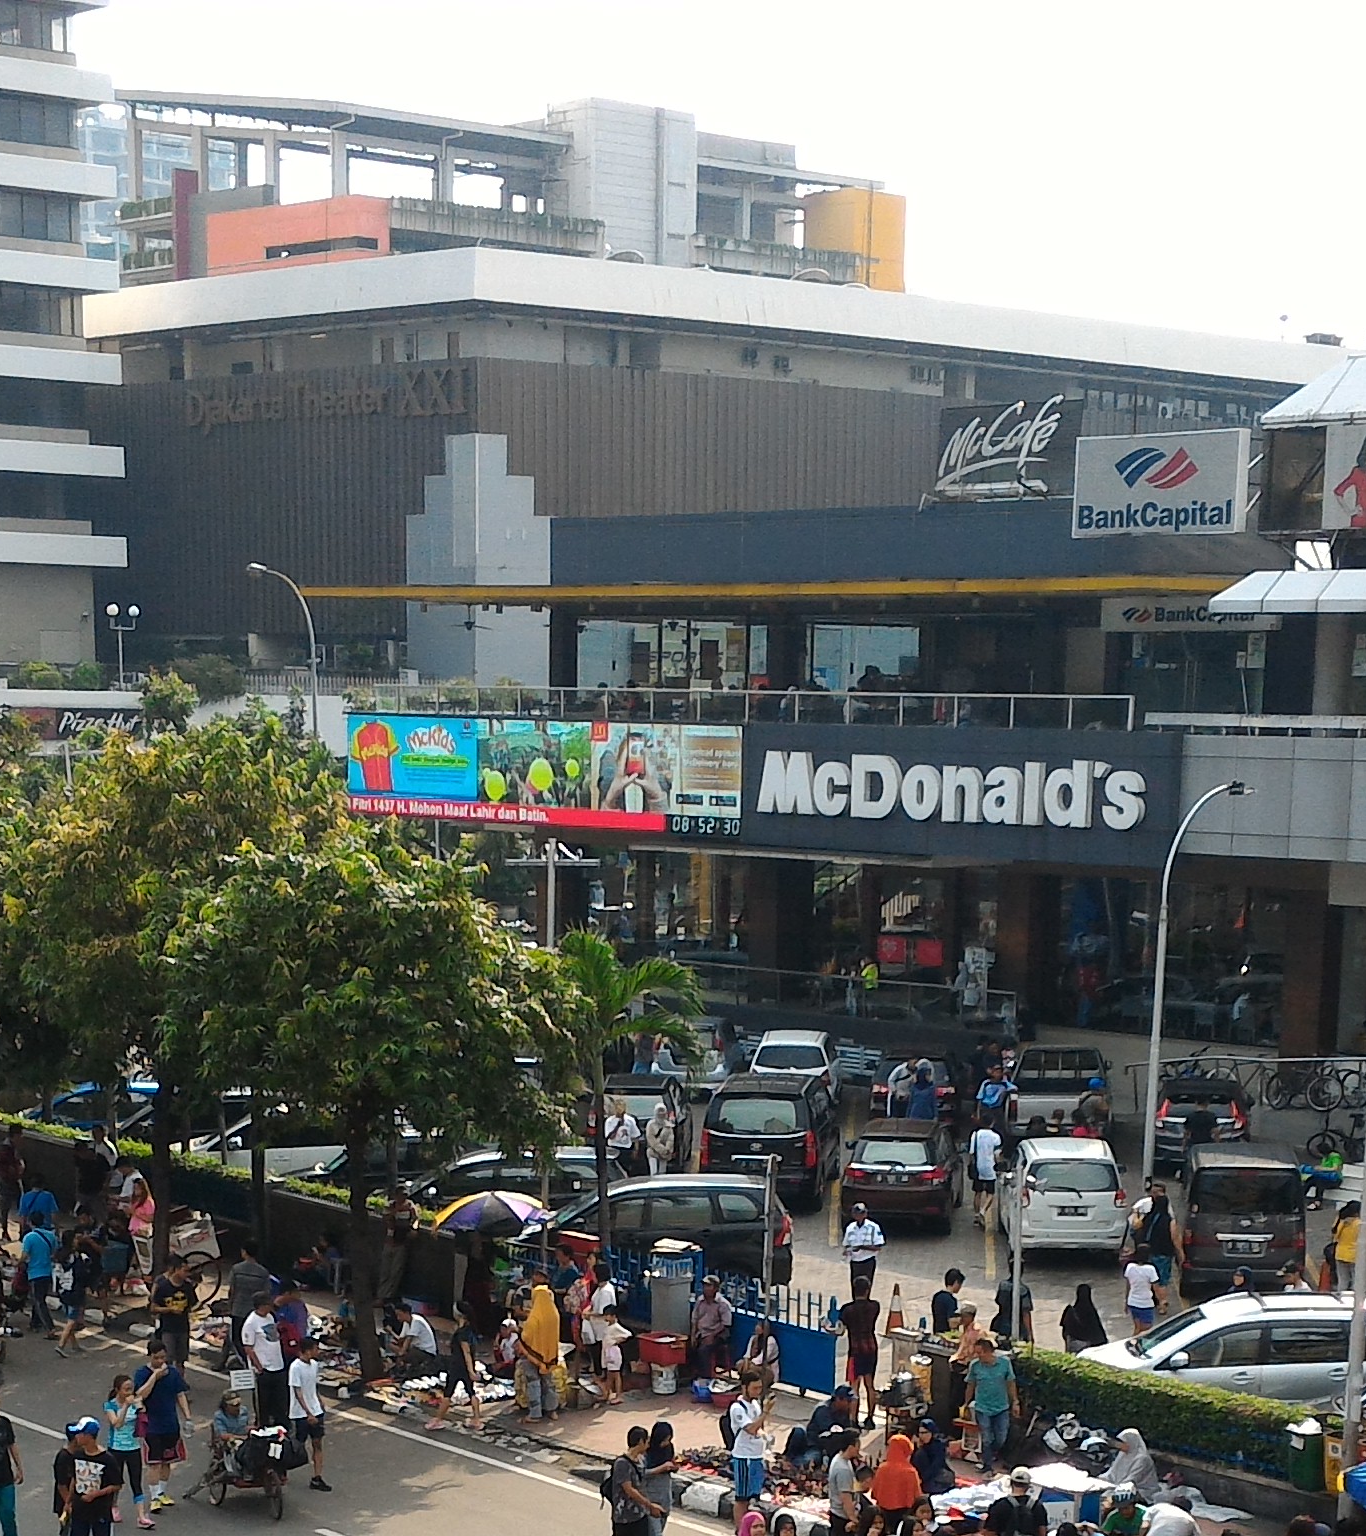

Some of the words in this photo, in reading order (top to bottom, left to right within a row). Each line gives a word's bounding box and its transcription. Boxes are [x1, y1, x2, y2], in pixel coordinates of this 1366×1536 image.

[395, 367, 469, 417] XXI
[938, 394, 1064, 477] McCafé
[1078, 500, 1232, 532] BankCapital
[405, 723, 456, 755] McKids
[374, 799, 395, 812] 1437
[410, 802, 443, 816] Mohon
[445, 804, 469, 817] Maaf
[470, 805, 496, 819] Lahir
[498, 807, 516, 820] dan
[756, 750, 1147, 831] McDonald's
